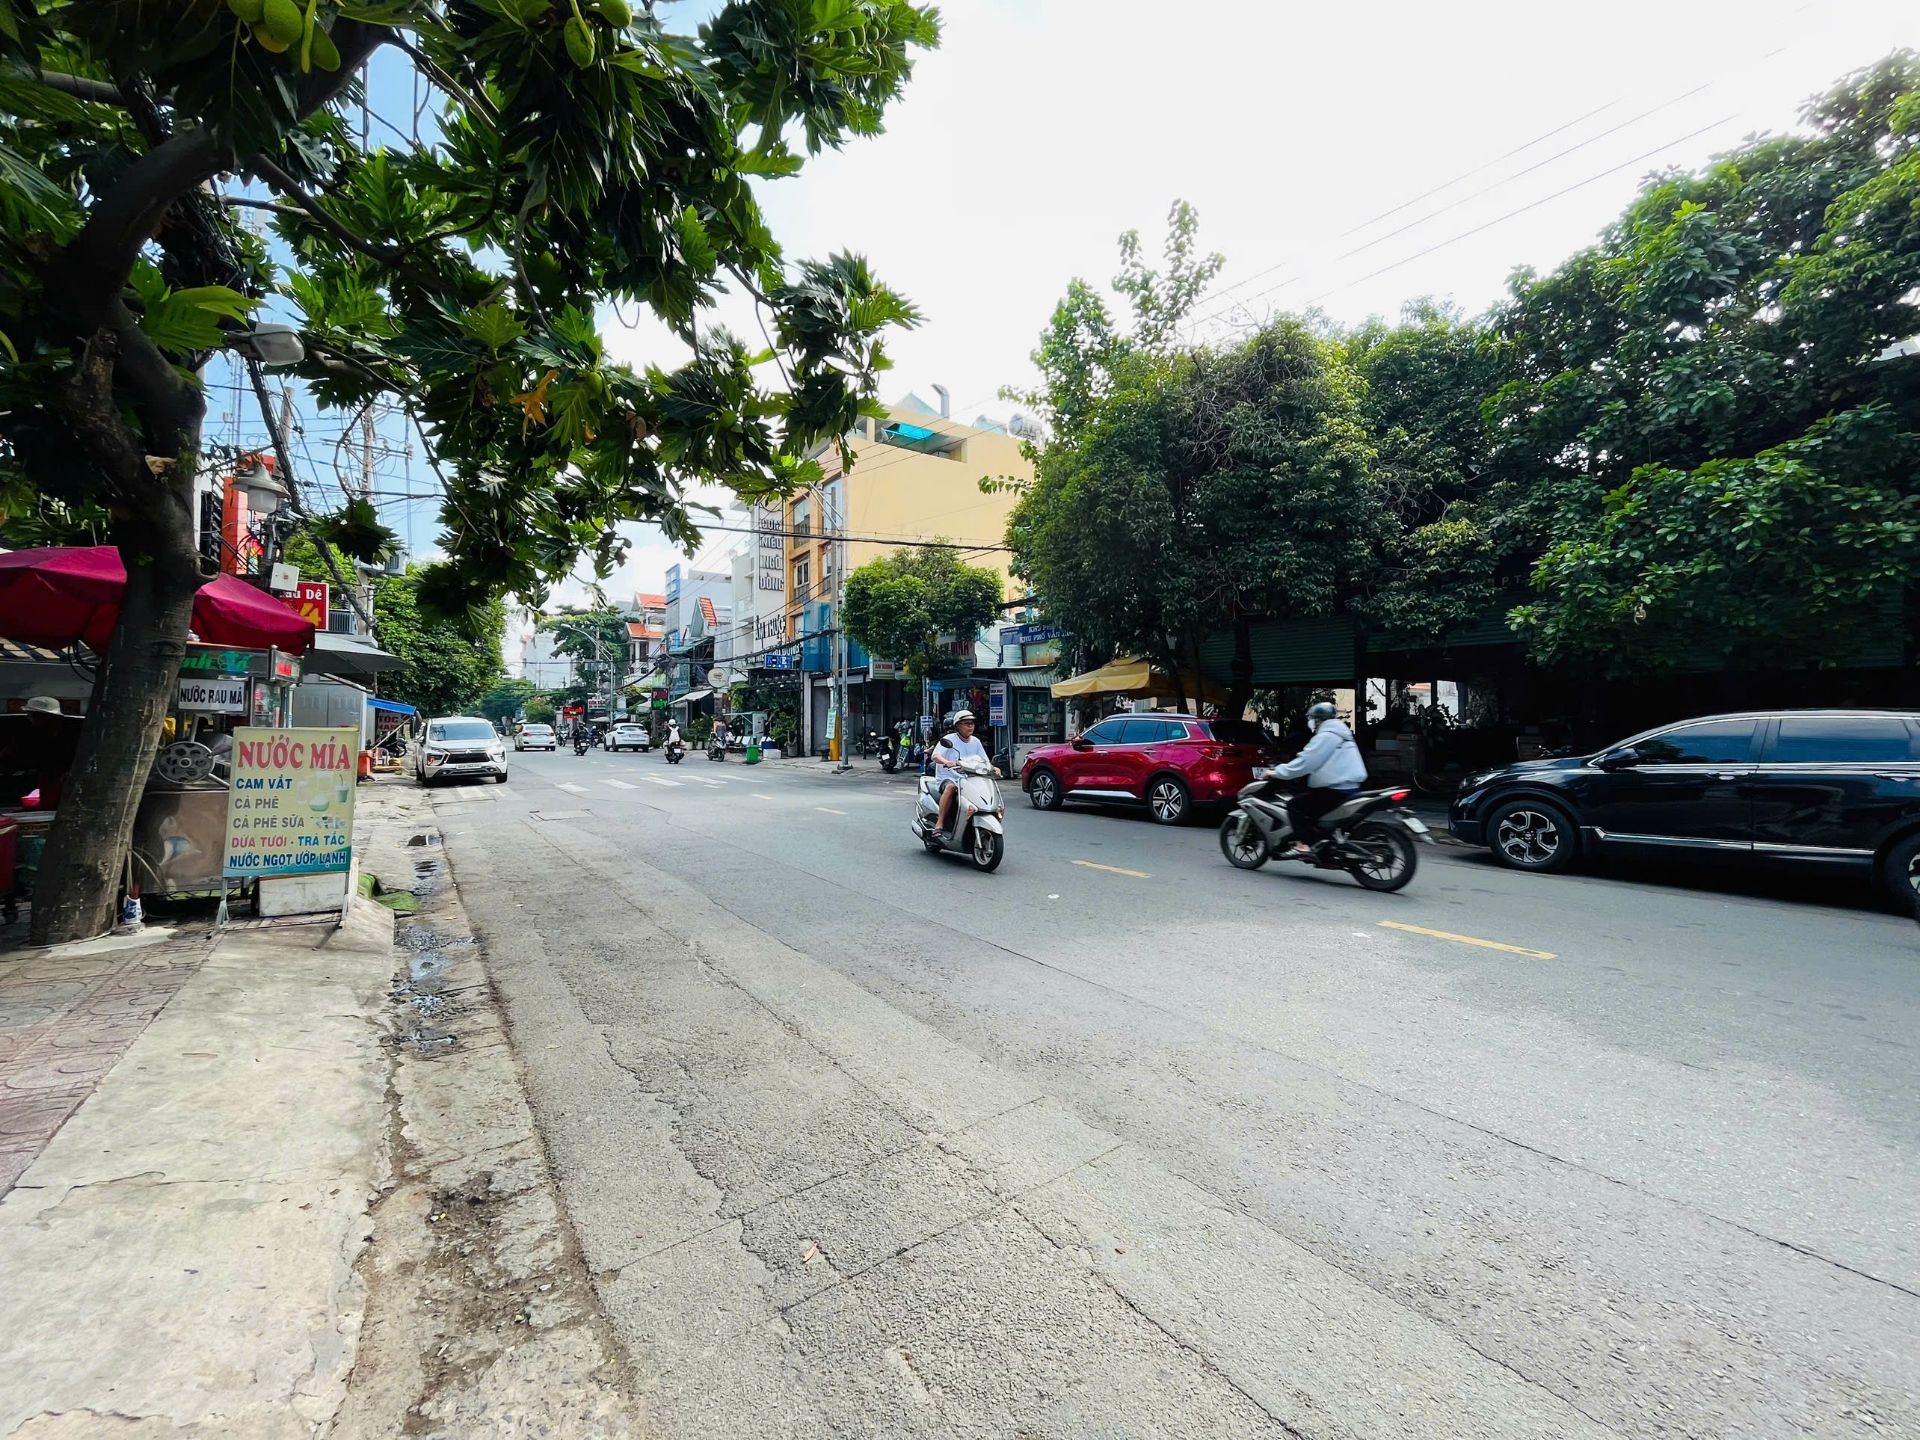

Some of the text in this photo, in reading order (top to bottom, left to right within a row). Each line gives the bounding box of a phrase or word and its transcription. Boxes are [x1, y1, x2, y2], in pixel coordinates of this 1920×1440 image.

[305, 589, 322, 600] Dê
[180, 684, 243, 704] NƯỚC RAU MÁ
[238, 734, 350, 769] NƯỚC MÍA
[236, 774, 292, 789] CAM VẮT
[235, 796, 279, 809] CÀ PHÊ
[233, 814, 305, 828] CÀ PHÊ SỮA
[260, 834, 287, 847] TƯƠI
[298, 832, 319, 846] TRÀ
[323, 831, 345, 845] TẮC
[230, 850, 346, 868] NƯỚC NGỌT ƯỚP LẠNH
